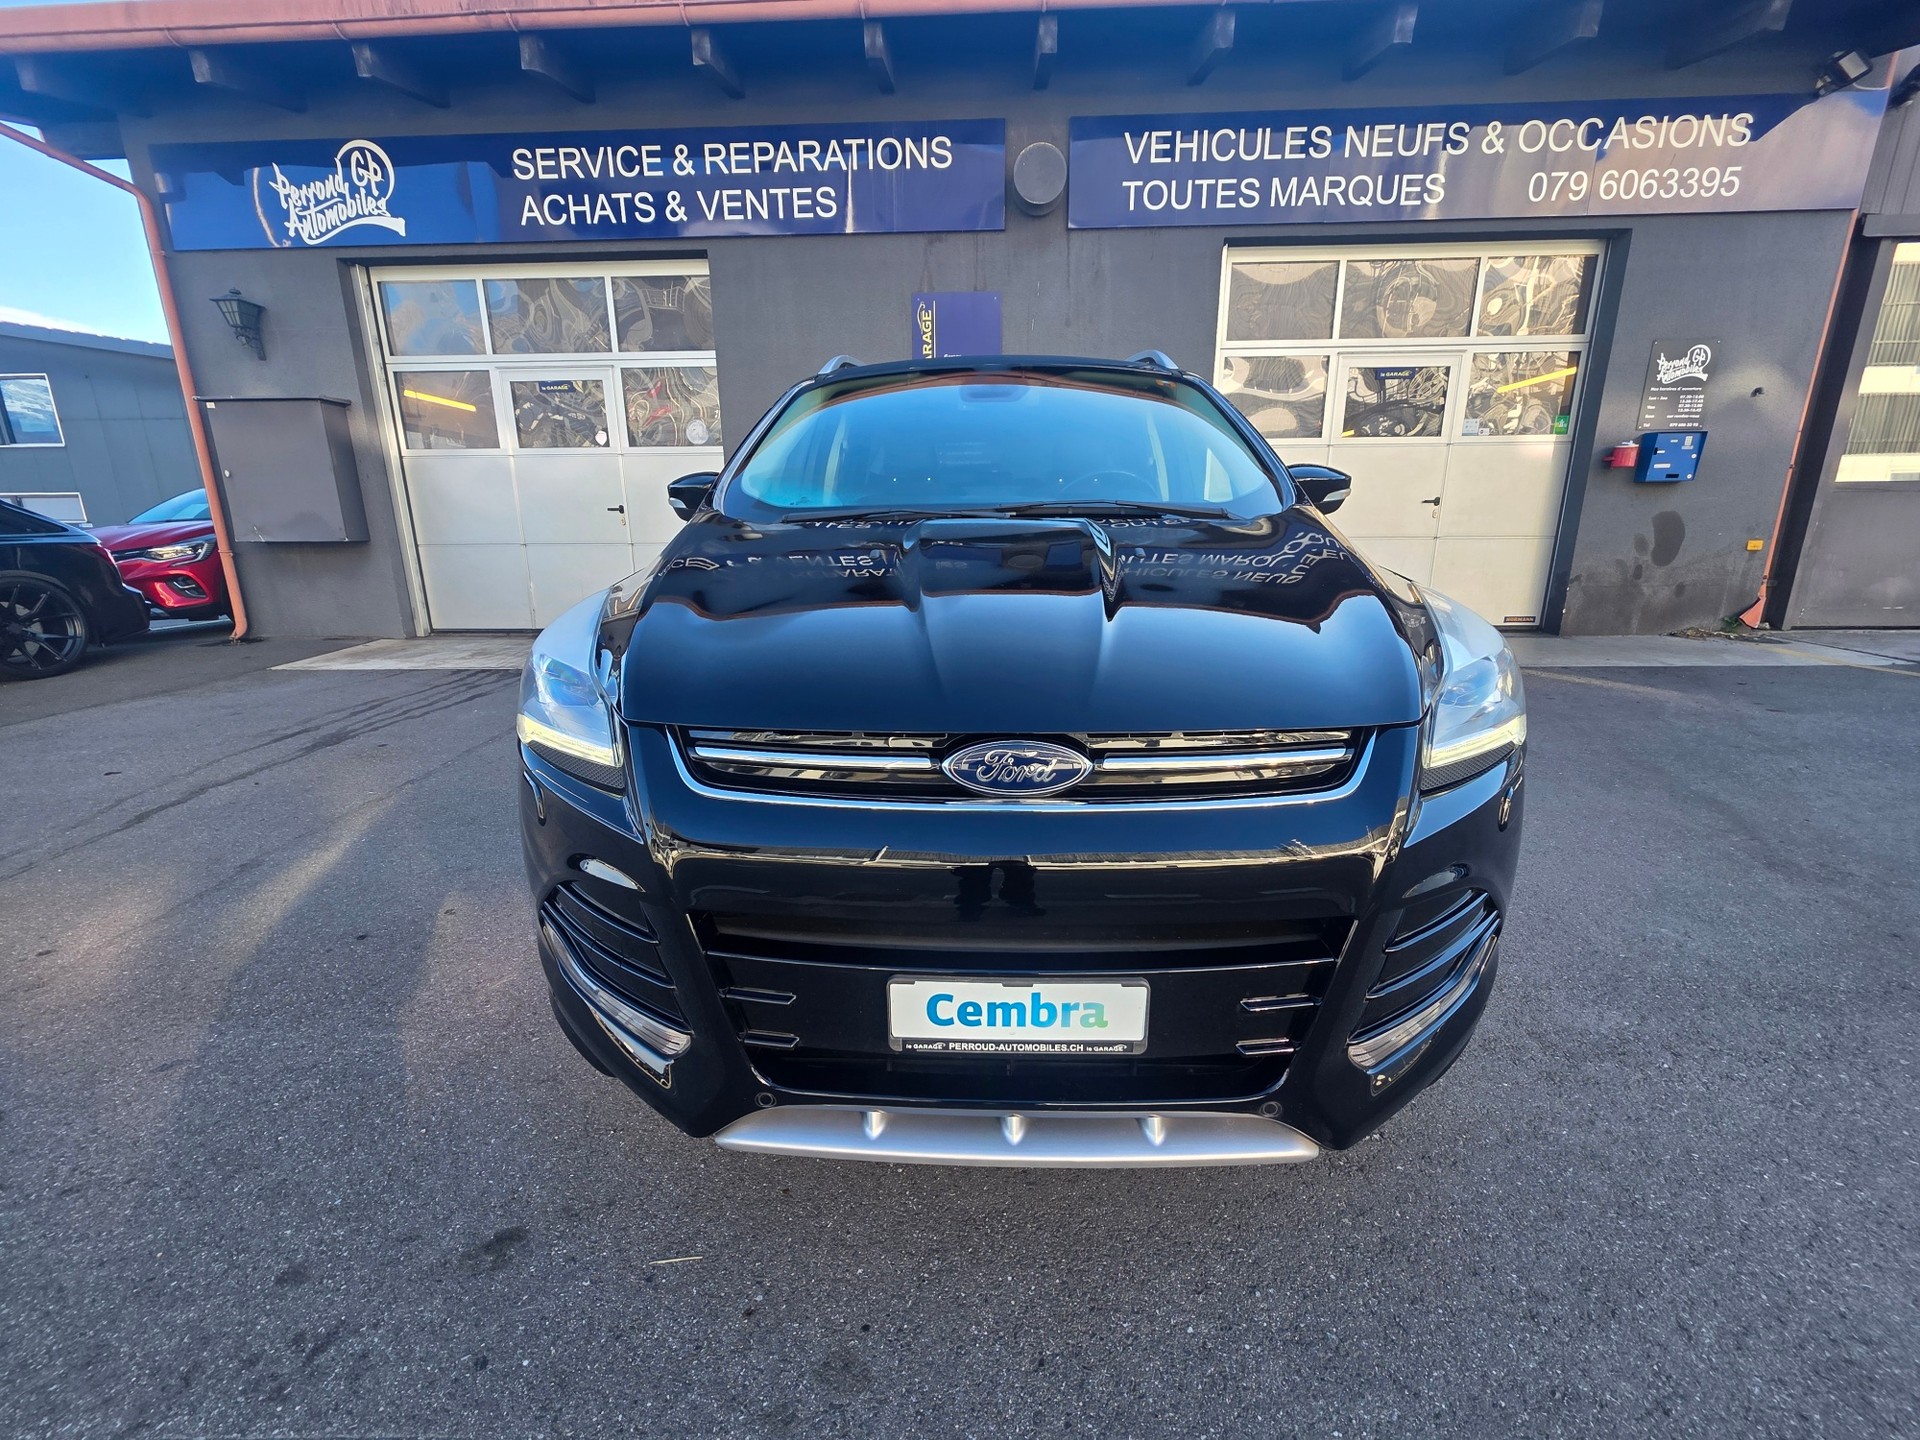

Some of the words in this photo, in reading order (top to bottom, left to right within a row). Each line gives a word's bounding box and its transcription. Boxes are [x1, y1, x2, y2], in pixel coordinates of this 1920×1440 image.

[1124, 125, 1332, 164] VEHICULES
[1344, 121, 1471, 158] NEUFS
[1481, 120, 1505, 154] &
[1518, 112, 1754, 153] OCCASIONS
[512, 144, 664, 180] SERVICE
[672, 143, 696, 176] &
[703, 136, 953, 175] REPARATIONS
[1122, 177, 1261, 211] TOUTES
[1270, 173, 1446, 207] MARQUES
[1528, 171, 1588, 202] 079
[1599, 166, 1742, 200] 6063395
[520, 191, 656, 226] ACHATS
[665, 190, 688, 223] &
[696, 186, 838, 221] VENTES
[976, 749, 1058, 783] Ford
[926, 991, 1109, 1029] Cembra
[913, 1042, 944, 1050] GARAGE
[949, 1042, 1084, 1053] PERROUD-AUTOMOBILES.CH
